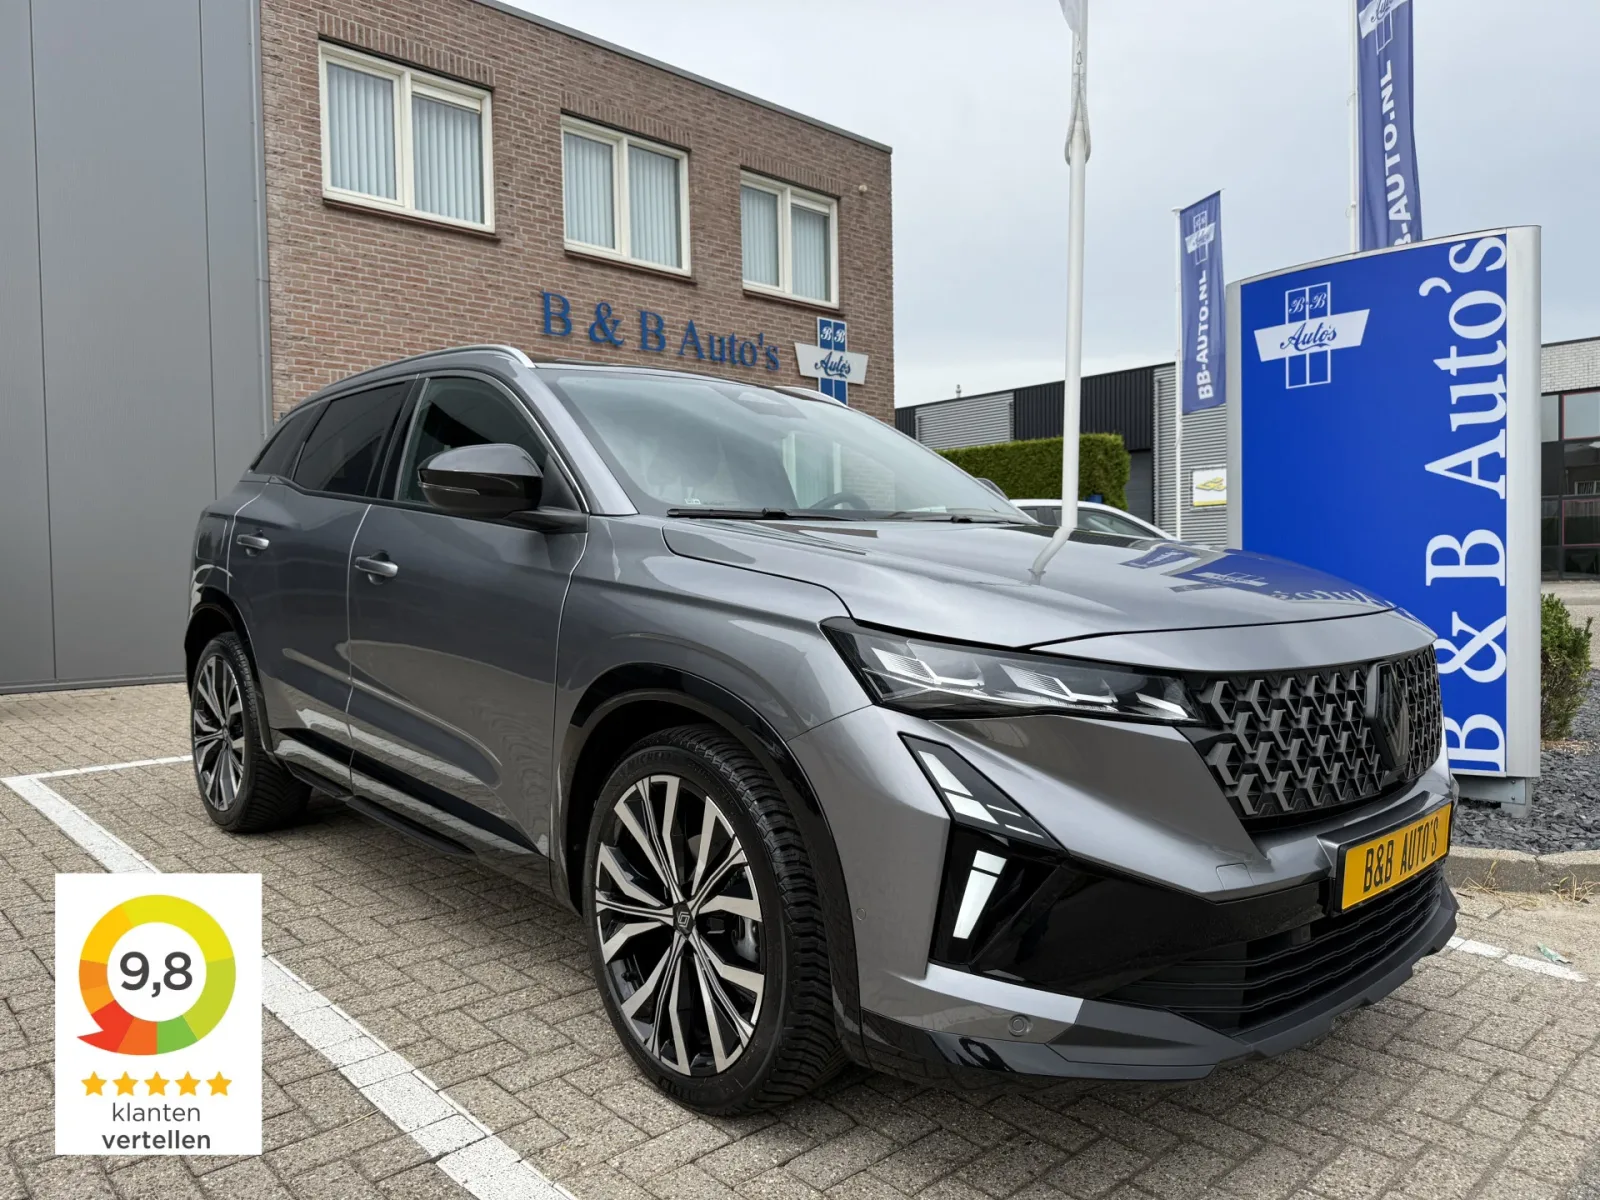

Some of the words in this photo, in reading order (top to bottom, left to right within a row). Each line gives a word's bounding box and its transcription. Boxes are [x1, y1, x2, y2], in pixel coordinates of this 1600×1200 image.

[541, 290, 573, 337] B
[588, 302, 626, 347] &
[638, 309, 667, 352] B
[677, 318, 781, 371] Auto's
[814, 351, 852, 379] Auto's
[1195, 269, 1214, 400] BB-AUTO.NL
[1279, 321, 1338, 352] Auto's
[1418, 236, 1508, 500] Auto's
[1425, 529, 1506, 587] B
[1434, 611, 1507, 683] &
[1442, 713, 1506, 773] B
[1362, 839, 1395, 894] B&B
[1399, 816, 1439, 876] AUTO'S
